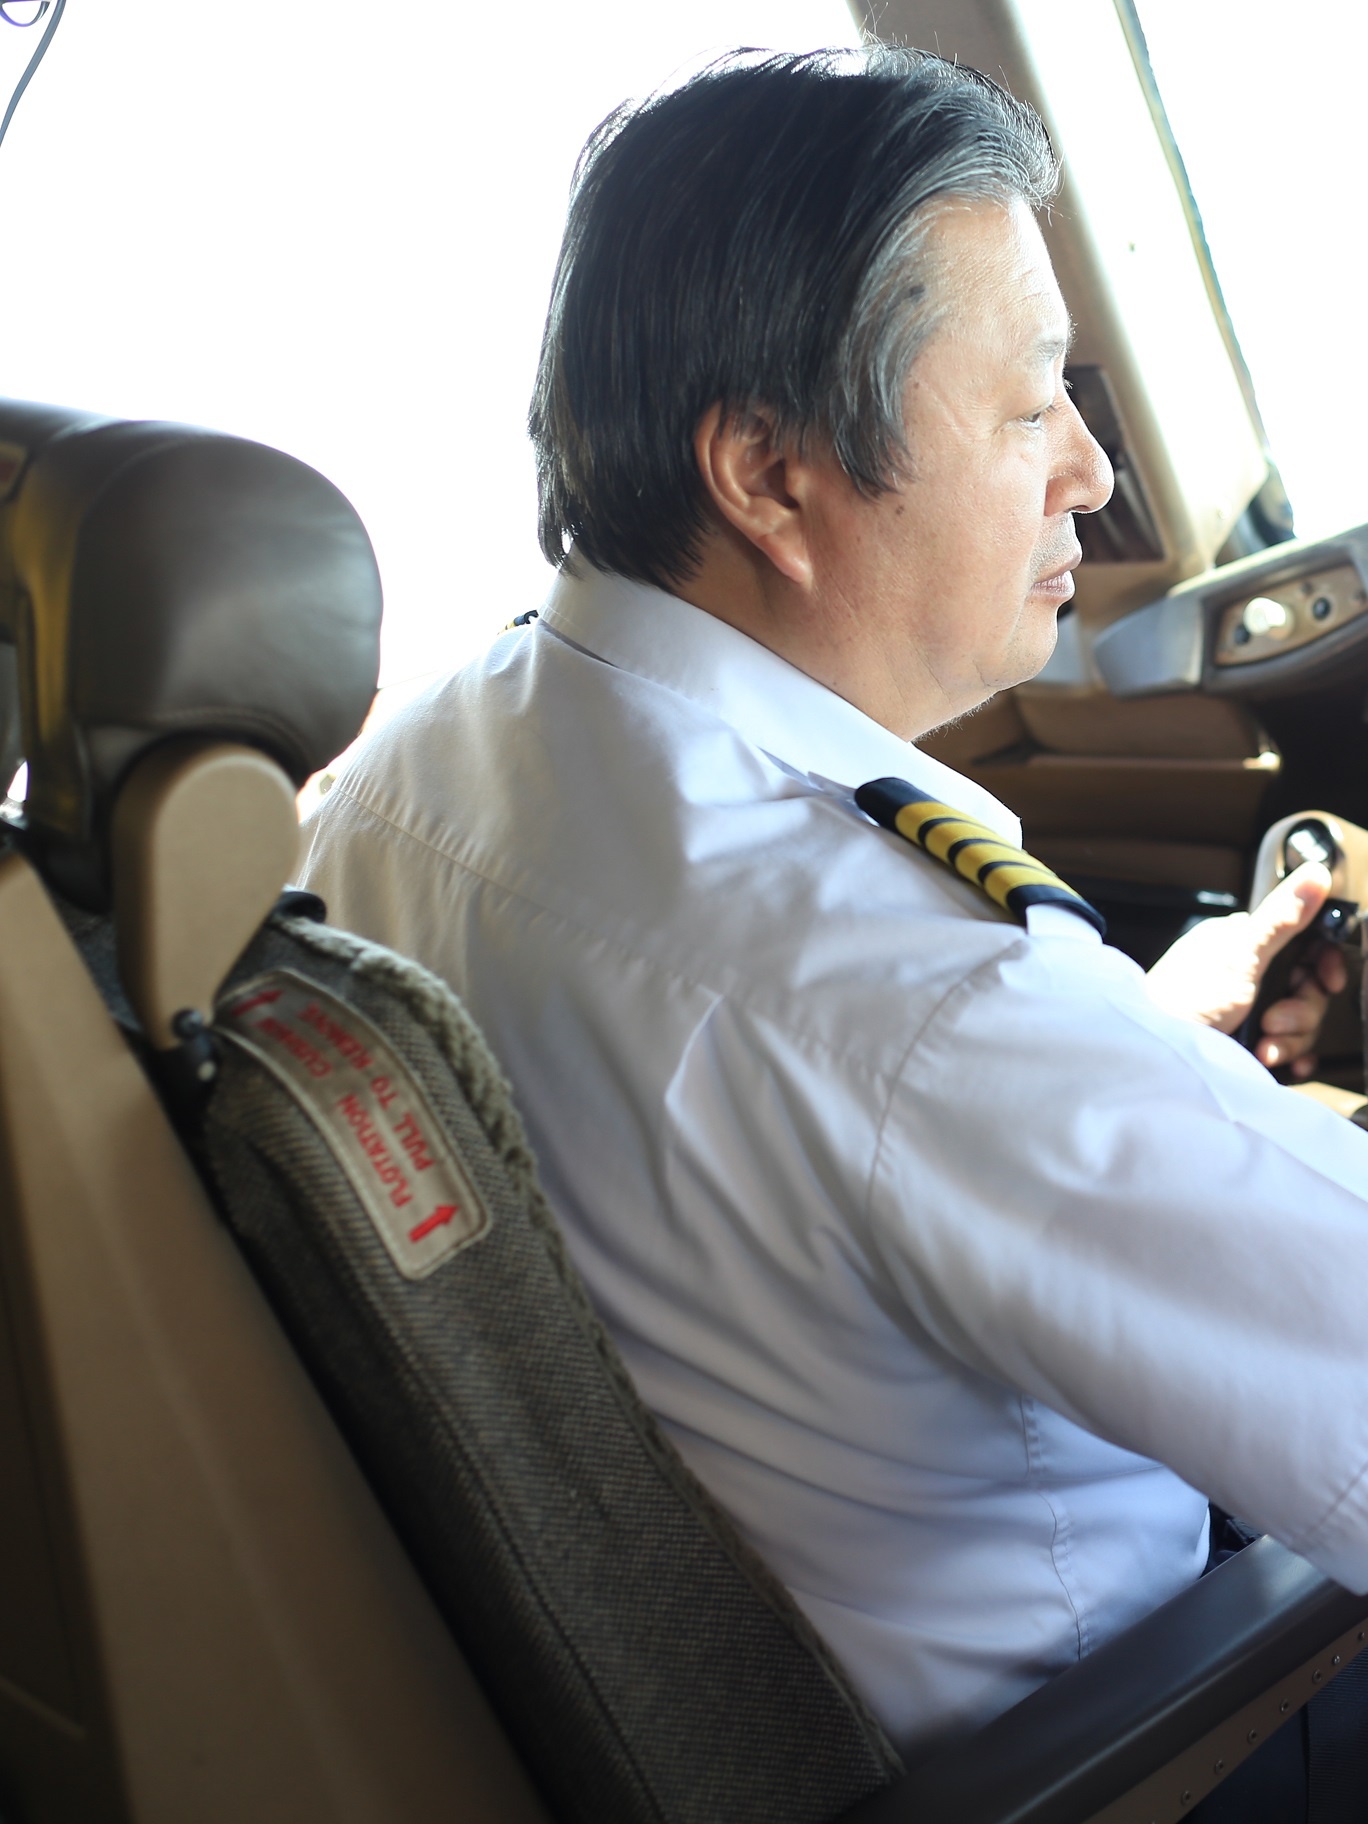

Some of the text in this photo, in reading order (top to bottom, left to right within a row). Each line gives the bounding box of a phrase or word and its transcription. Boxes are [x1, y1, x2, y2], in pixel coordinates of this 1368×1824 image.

[370, 1076, 398, 1110] TO
[337, 1093, 415, 1208] FLOTATION
[393, 1112, 434, 1171] PULL
